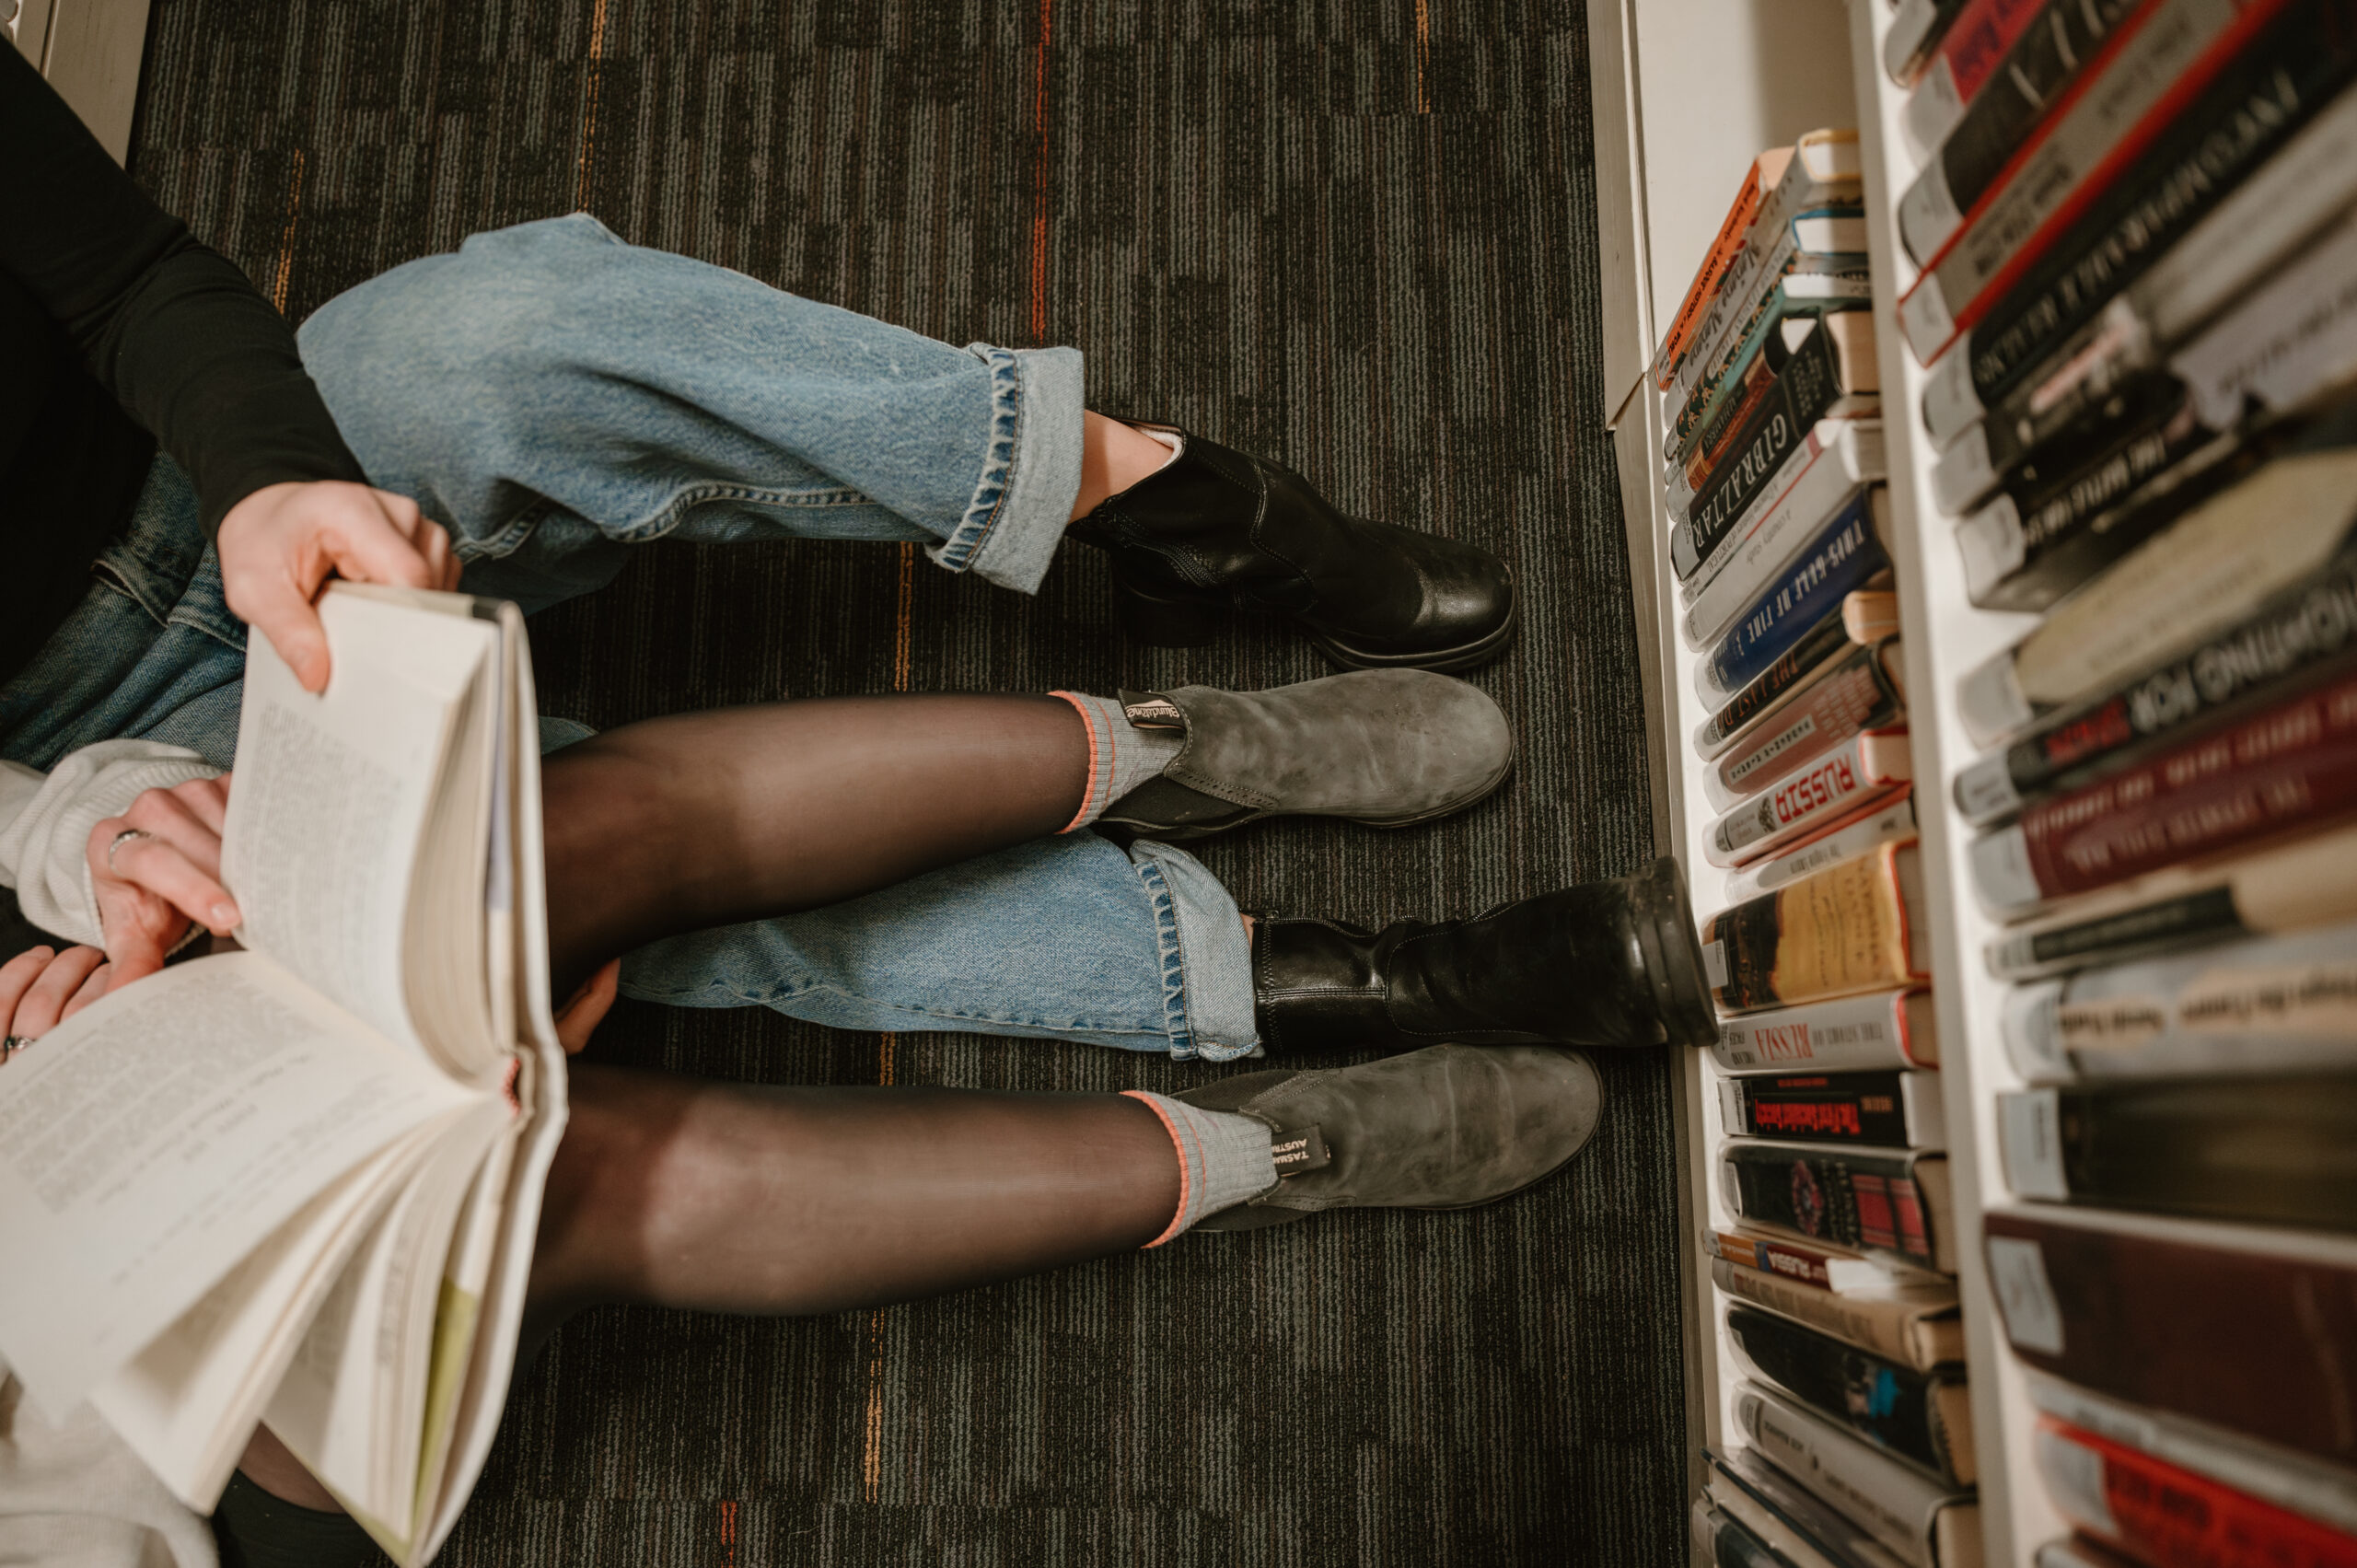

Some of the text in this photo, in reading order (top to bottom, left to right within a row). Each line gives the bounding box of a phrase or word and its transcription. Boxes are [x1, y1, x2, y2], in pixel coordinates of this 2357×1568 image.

[1692, 413, 1787, 549] GIBRALTAR
[1126, 707, 1179, 718] Blundstone
[1776, 752, 1857, 824] RUSSIA
[1753, 1022, 1812, 1061] RUSSIA
